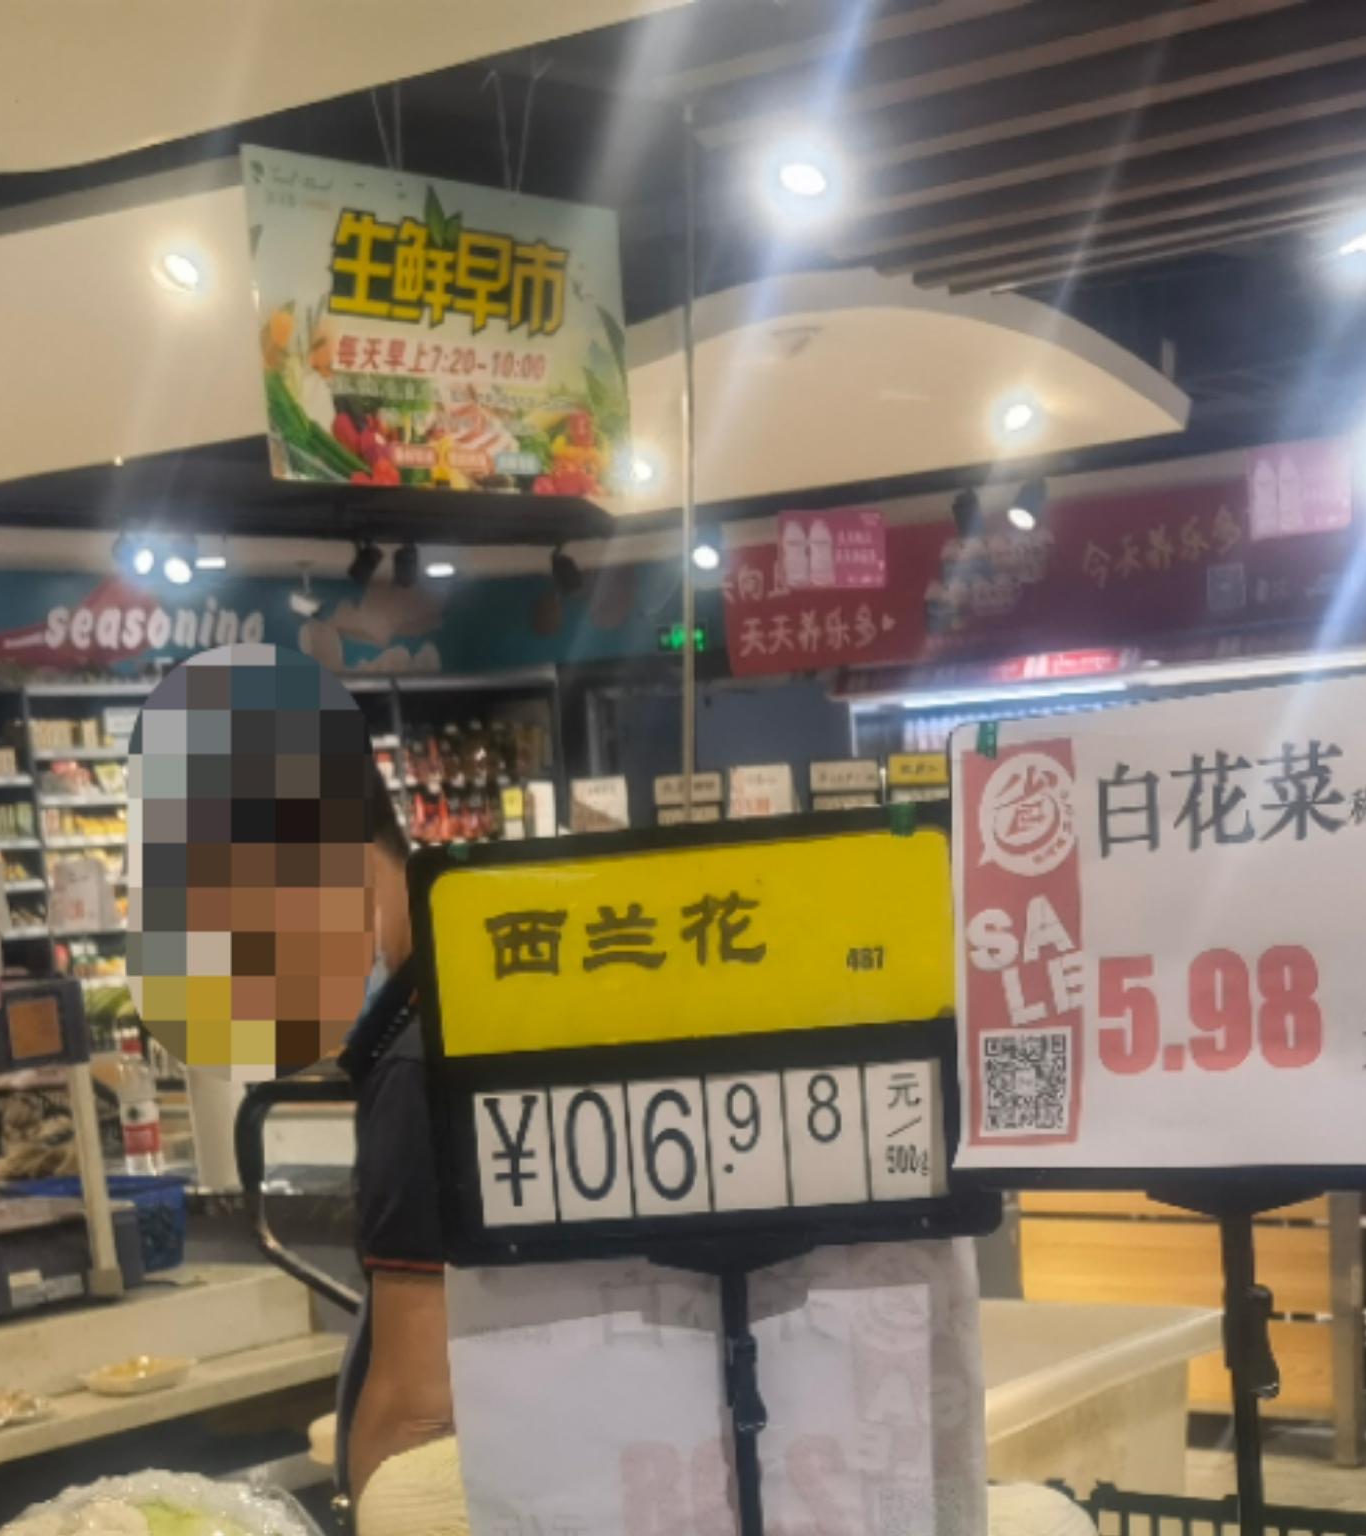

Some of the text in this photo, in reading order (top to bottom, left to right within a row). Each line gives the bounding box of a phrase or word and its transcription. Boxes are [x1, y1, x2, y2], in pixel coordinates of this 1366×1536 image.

[329, 208, 570, 337] 生鲜早市
[1097, 739, 1347, 858] 白花菜
[483, 891, 767, 981] 西兰花
[1097, 944, 1323, 1076] 5.98
